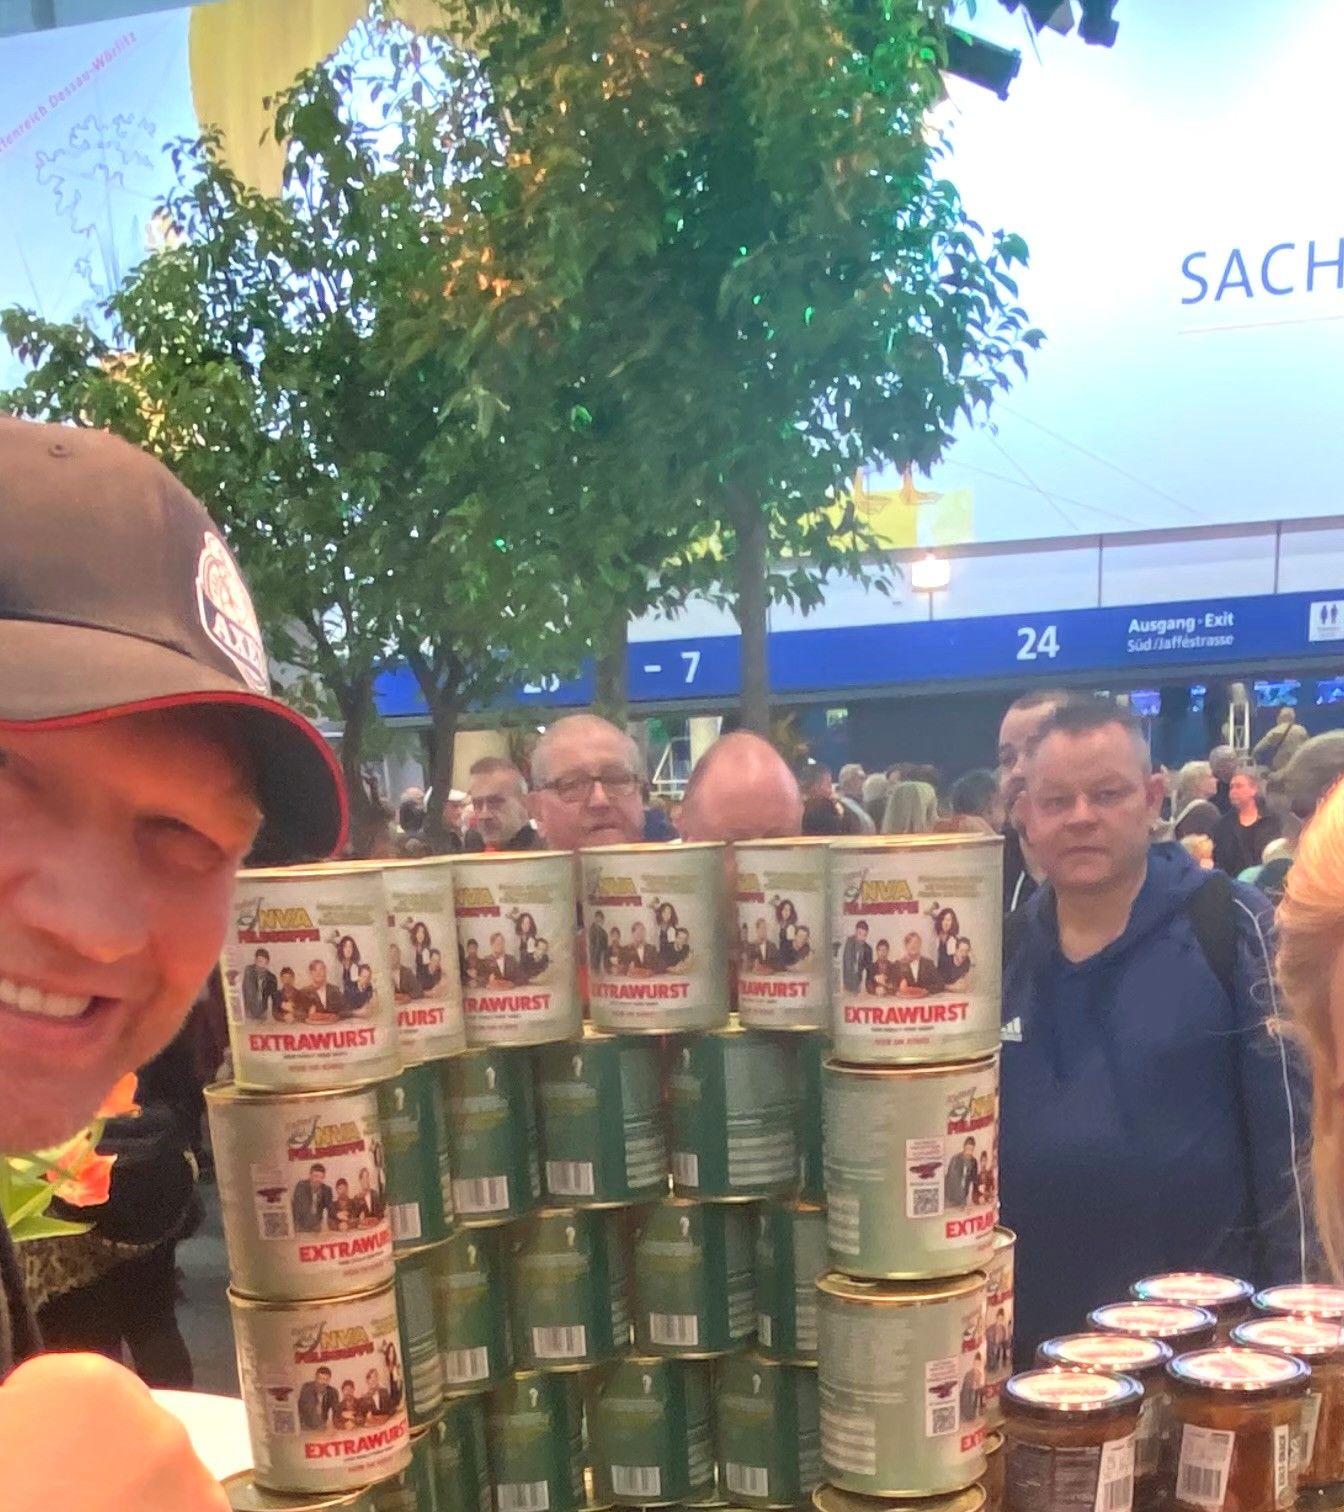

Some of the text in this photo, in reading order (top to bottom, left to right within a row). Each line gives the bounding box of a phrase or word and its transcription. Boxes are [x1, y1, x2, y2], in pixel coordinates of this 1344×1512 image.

[1128, 611, 1234, 635] Ausgang Exit
[1016, 625, 1060, 660] 24
[681, 651, 701, 683] 7
[844, 1002, 969, 1025] EXTRAWURST
[248, 1026, 377, 1052] EXTRAWURST
